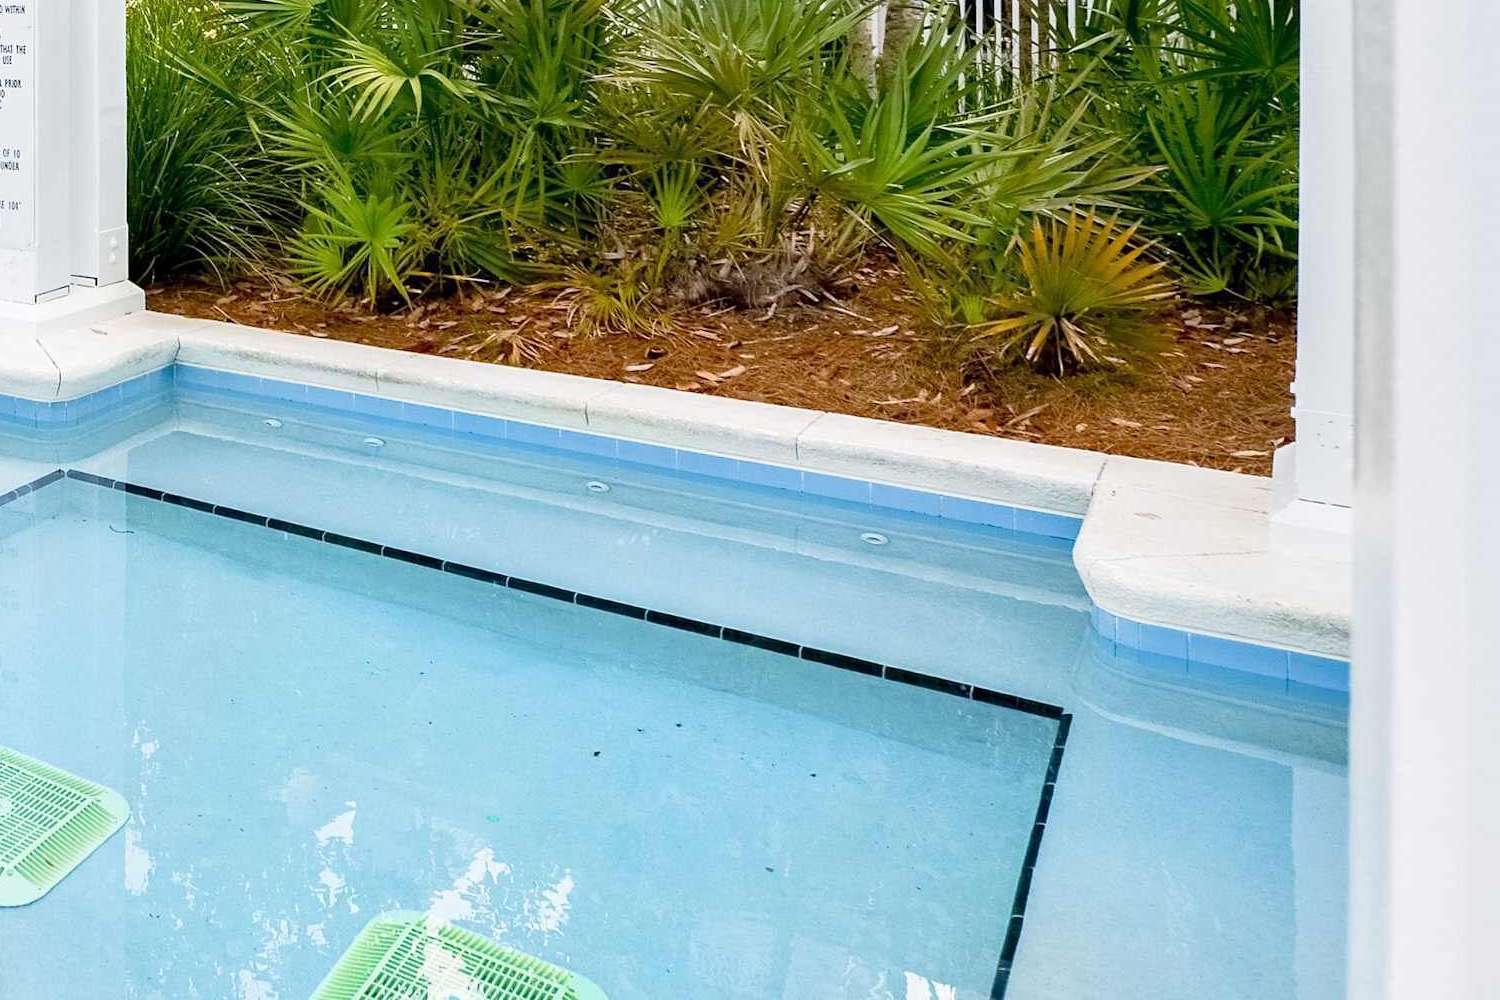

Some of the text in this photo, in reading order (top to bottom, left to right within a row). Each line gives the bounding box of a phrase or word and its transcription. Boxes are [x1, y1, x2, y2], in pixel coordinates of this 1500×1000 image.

[5, 5, 25, 14] WITHIN
[0, 45, 13, 53] THAT
[16, 45, 26, 54] THE
[3, 56, 12, 64] USE
[5, 79, 21, 88] PRIOR
[3, 149, 10, 157] OF
[14, 150, 20, 158] 10
[1, 161, 19, 170] UNDER
